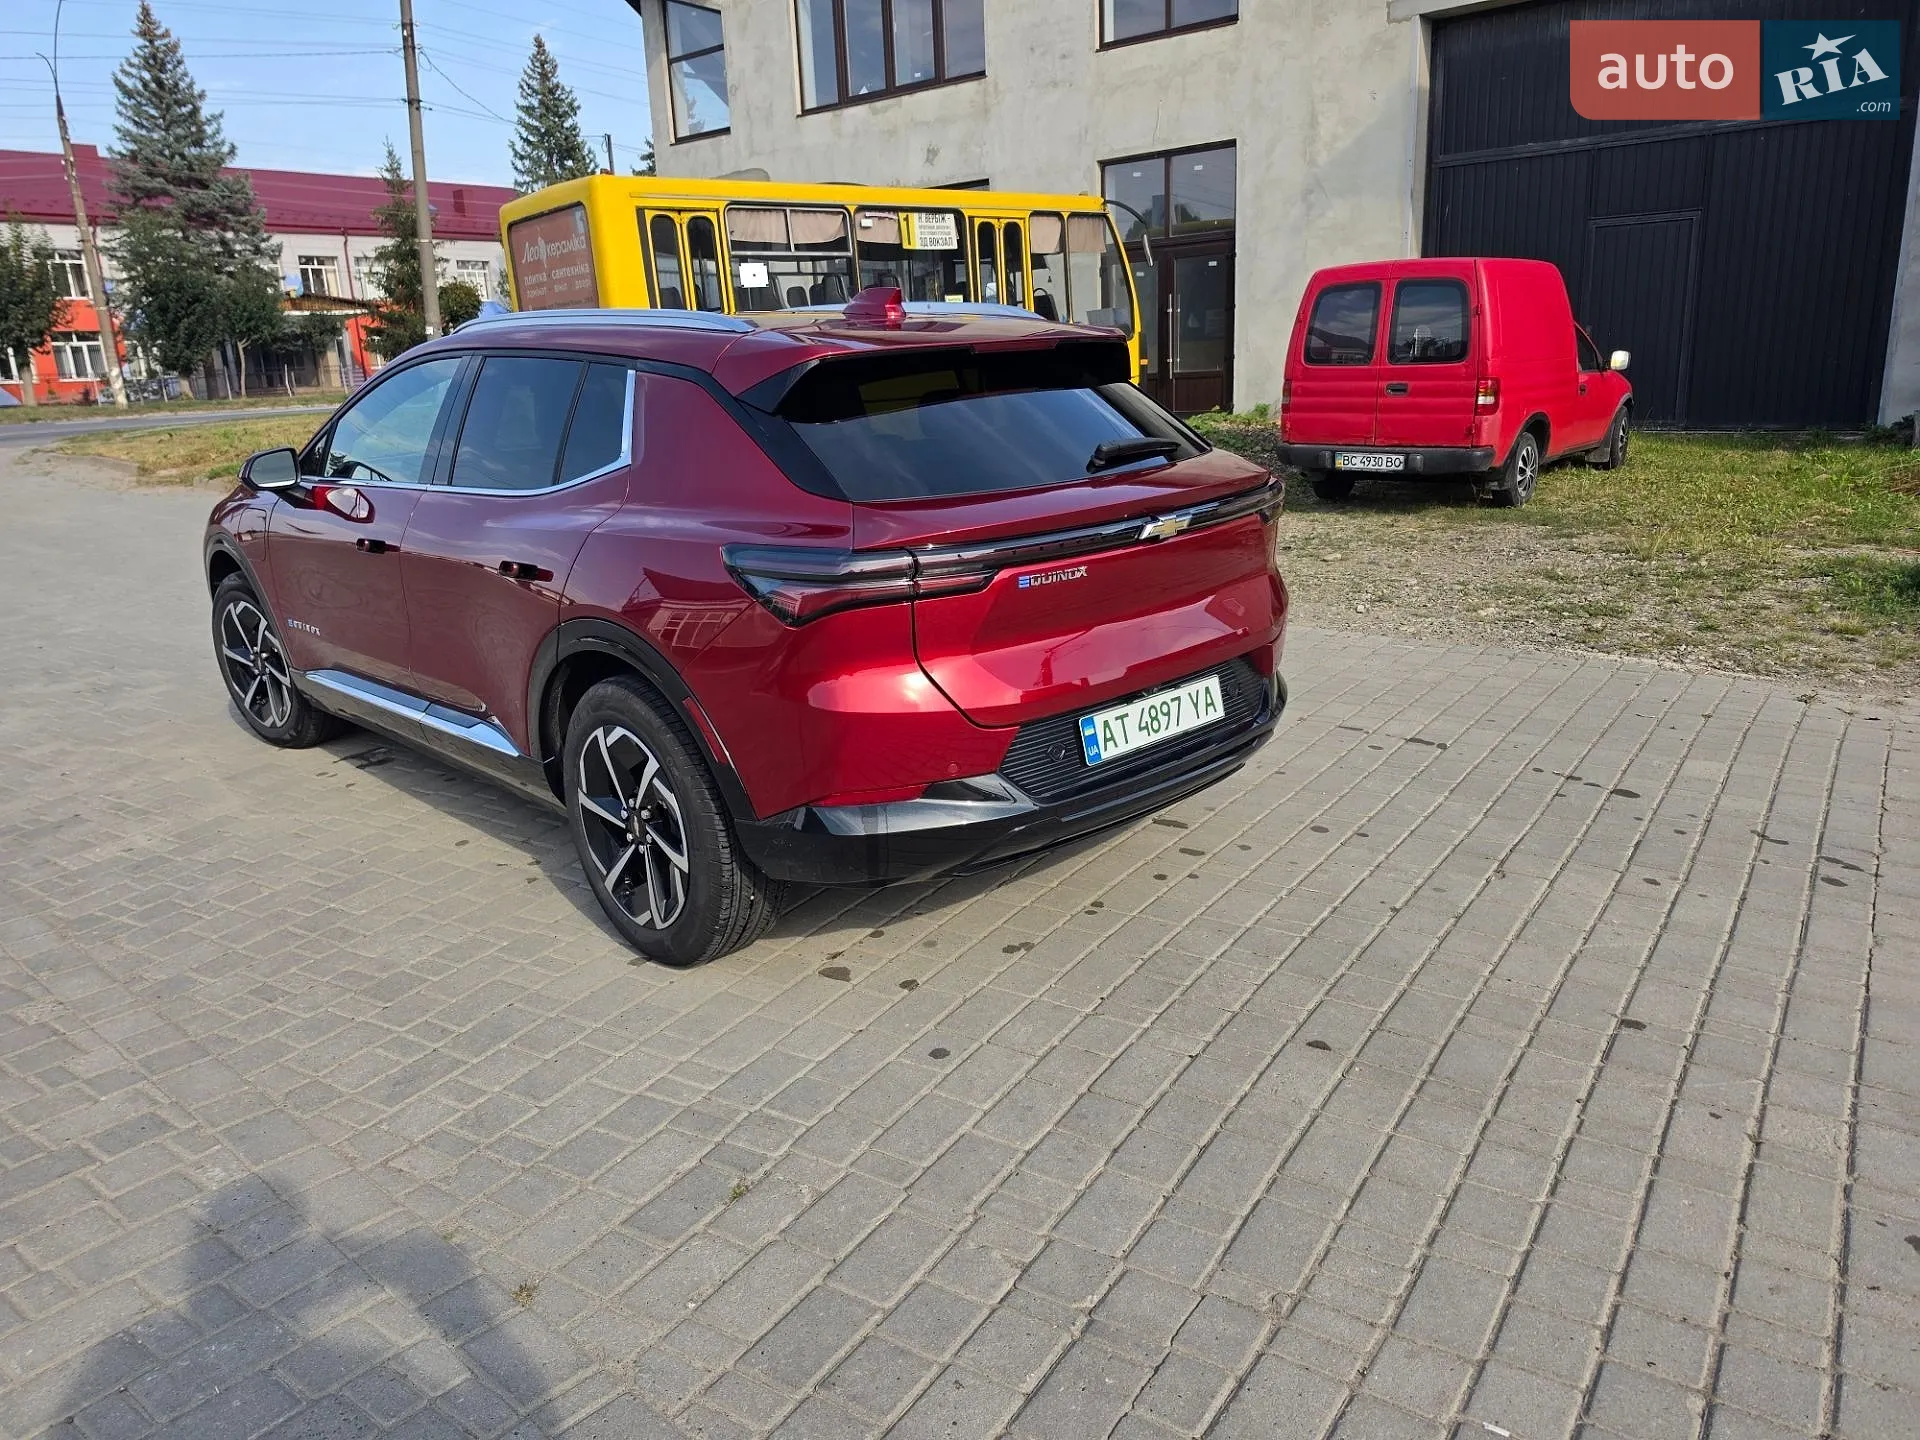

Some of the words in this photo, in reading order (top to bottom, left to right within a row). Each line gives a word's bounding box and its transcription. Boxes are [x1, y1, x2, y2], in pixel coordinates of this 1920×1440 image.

[903, 214, 912, 246] 1
[546, 233, 587, 258] кераміка
[551, 261, 591, 280] сантехніка
[1342, 455, 1358, 467] BC
[1360, 455, 1384, 468] 4930
[1385, 456, 1402, 468] BO
[1018, 566, 1088, 588] EQUINOX
[1102, 712, 1129, 751] AT
[1138, 695, 1182, 737] 4897
[1188, 685, 1218, 720] YA
[1088, 746, 1100, 756] UA
